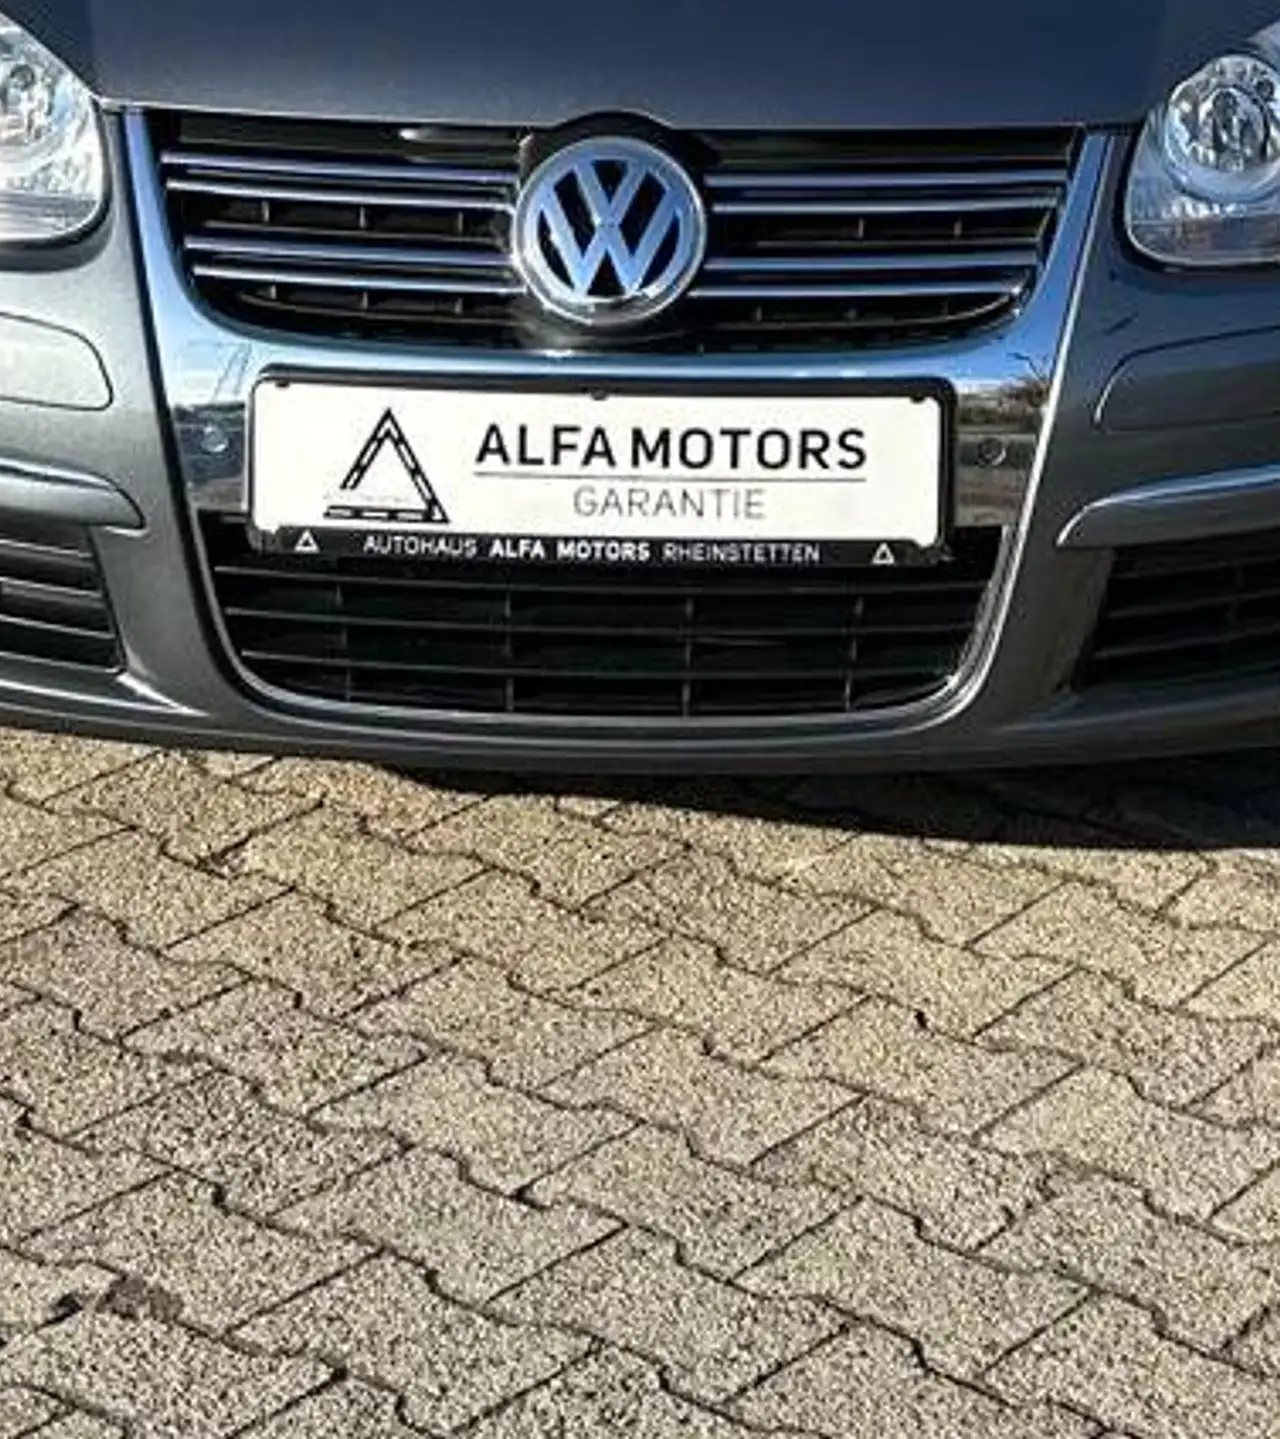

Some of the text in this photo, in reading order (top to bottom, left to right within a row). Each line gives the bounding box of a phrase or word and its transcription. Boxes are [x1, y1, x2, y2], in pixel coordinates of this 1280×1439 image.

[572, 484, 768, 521] GARANTIE
[363, 535, 820, 564] AUTOHAUS ALFA MOTORS RHEINSTETTEN
